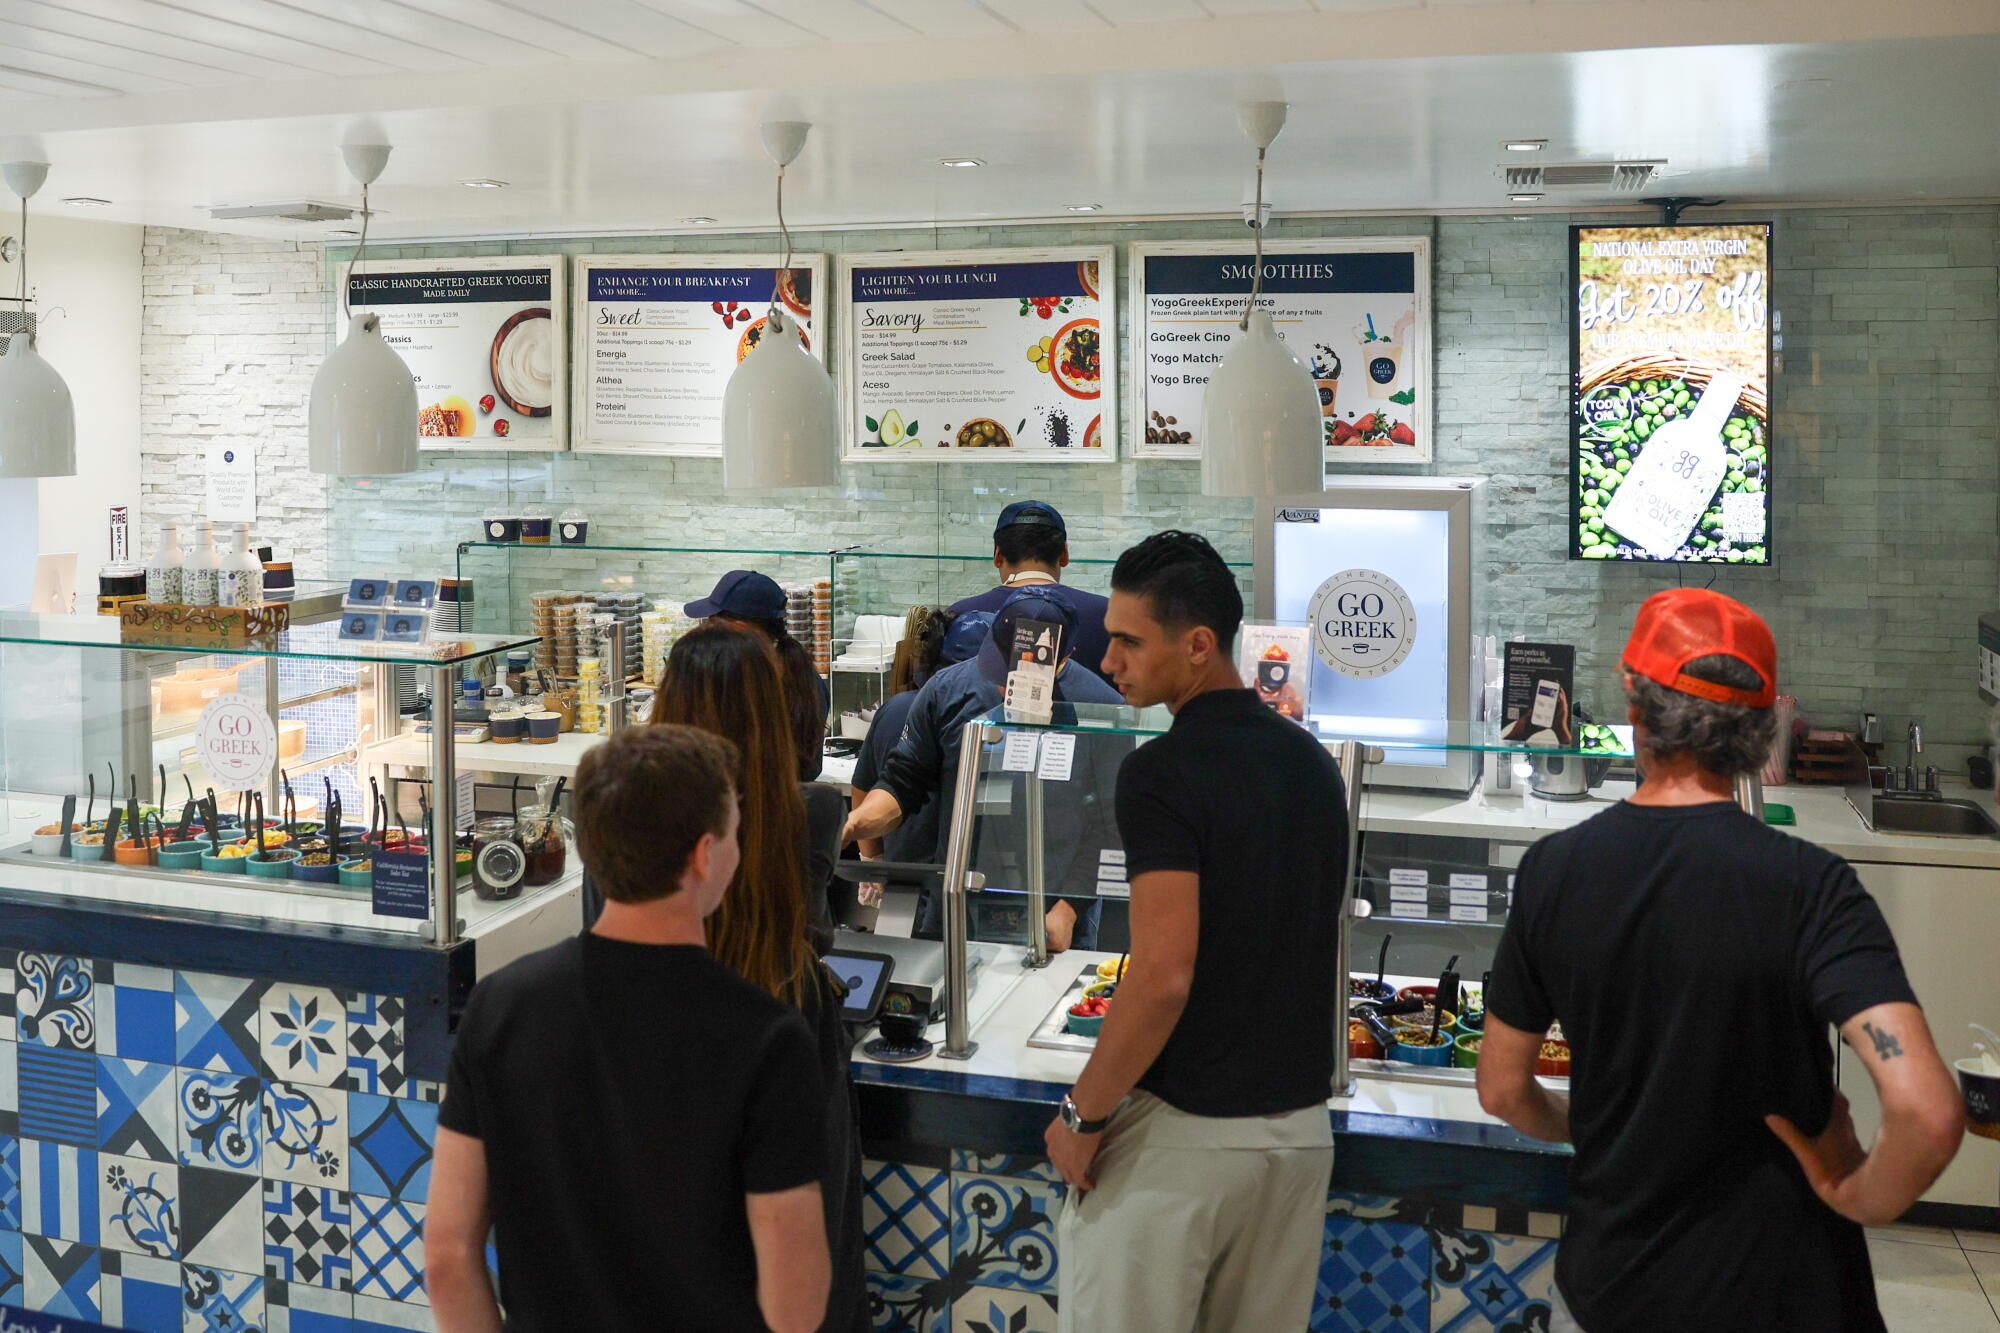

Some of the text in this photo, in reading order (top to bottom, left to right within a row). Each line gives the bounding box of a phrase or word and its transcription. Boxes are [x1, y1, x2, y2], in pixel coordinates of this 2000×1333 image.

[1593, 239, 1747, 257] NATIONAL EXTRA VIRGIN
[1622, 257, 1716, 274] OLIVE OIL DAY
[1221, 264, 1333, 280] SMOOTHIES
[349, 275, 550, 290] CLASSIC HANDCRAFTED GREEK YOGURT
[597, 276, 751, 287] ENHANCE YOUR BREAKFAST
[861, 273, 997, 286] LIGHTEN YOUR LUNCH
[423, 289, 471, 298] MADE DAILY
[862, 288, 880, 296] AND
[1579, 270, 1766, 332] Get 20% off
[596, 307, 642, 326] Sweet
[861, 308, 926, 333] Savory
[382, 335, 412, 344] Classics
[1150, 332, 1231, 342] GoGreek Cino
[596, 349, 627, 360] Energia
[862, 352, 916, 361] Greek Salad
[1150, 354, 1179, 365] Yogo
[1375, 362, 1390, 370] GO
[596, 376, 622, 385] Althea
[862, 381, 890, 389] Aceso
[1150, 375, 1179, 386] Yogo
[595, 402, 627, 411] Proteini
[1589, 400, 1629, 410] TODAY
[1594, 410, 1623, 421] ONLY
[1648, 494, 1682, 520] OLIVE
[111, 514, 126, 525] FIRE
[1649, 509, 1669, 528] OIL
[1722, 532, 1764, 543] SCAN HERE
[1317, 571, 1406, 602] AUTHENTIC
[1337, 592, 1384, 618] GO
[1325, 620, 1397, 639] GREEK
[218, 714, 252, 737] GO
[209, 738, 262, 756] GREEK
